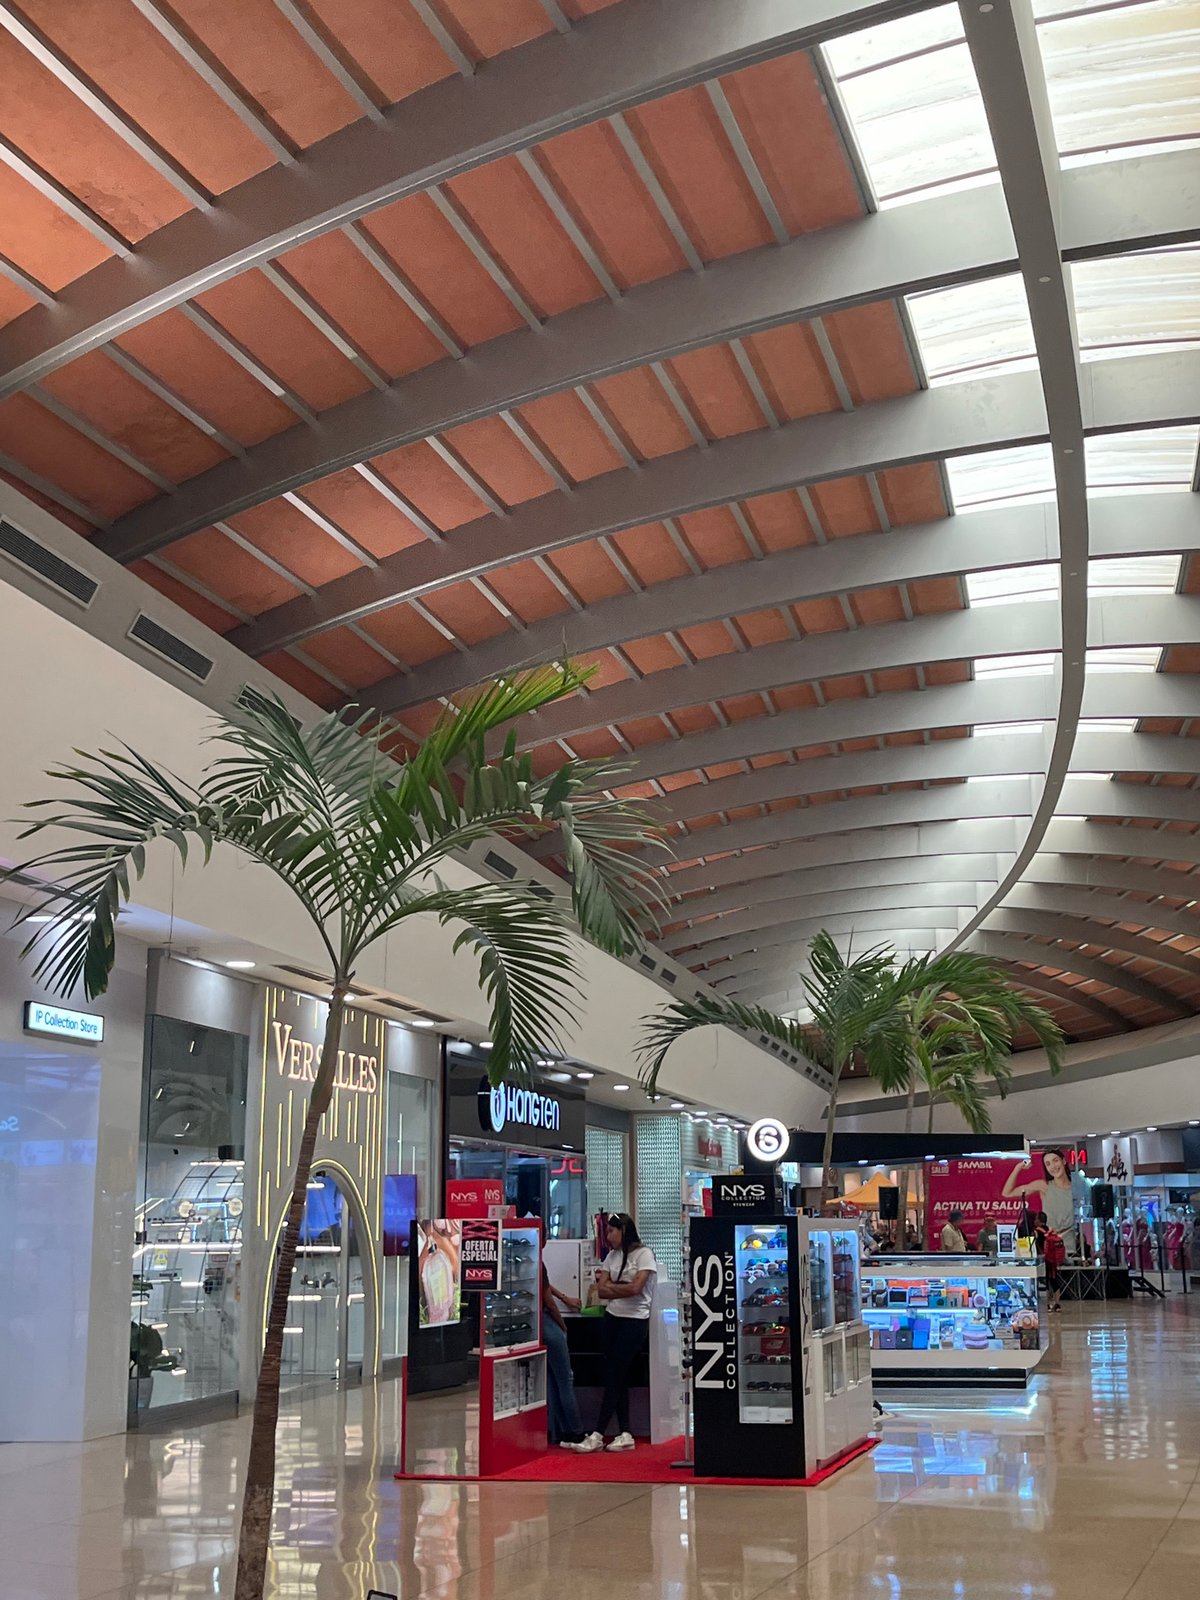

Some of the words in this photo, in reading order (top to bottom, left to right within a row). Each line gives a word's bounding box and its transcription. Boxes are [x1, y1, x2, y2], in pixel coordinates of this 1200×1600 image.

[44, 1011, 79, 1030] Collection
[80, 1019, 98, 1034] Store
[958, 1161, 993, 1169] SAMBIL
[450, 1191, 478, 1201] NYS
[484, 1189, 501, 1201] NYS
[721, 1184, 766, 1197] NYS
[933, 1202, 974, 1211] ACTIVA
[975, 1202, 990, 1211] TU
[465, 1240, 495, 1251] OFERTA
[462, 1250, 498, 1262] ESPECIAL
[465, 1269, 493, 1278] NYS
[693, 1254, 724, 1389] NYS
[724, 1253, 736, 1390] COLLECTION
